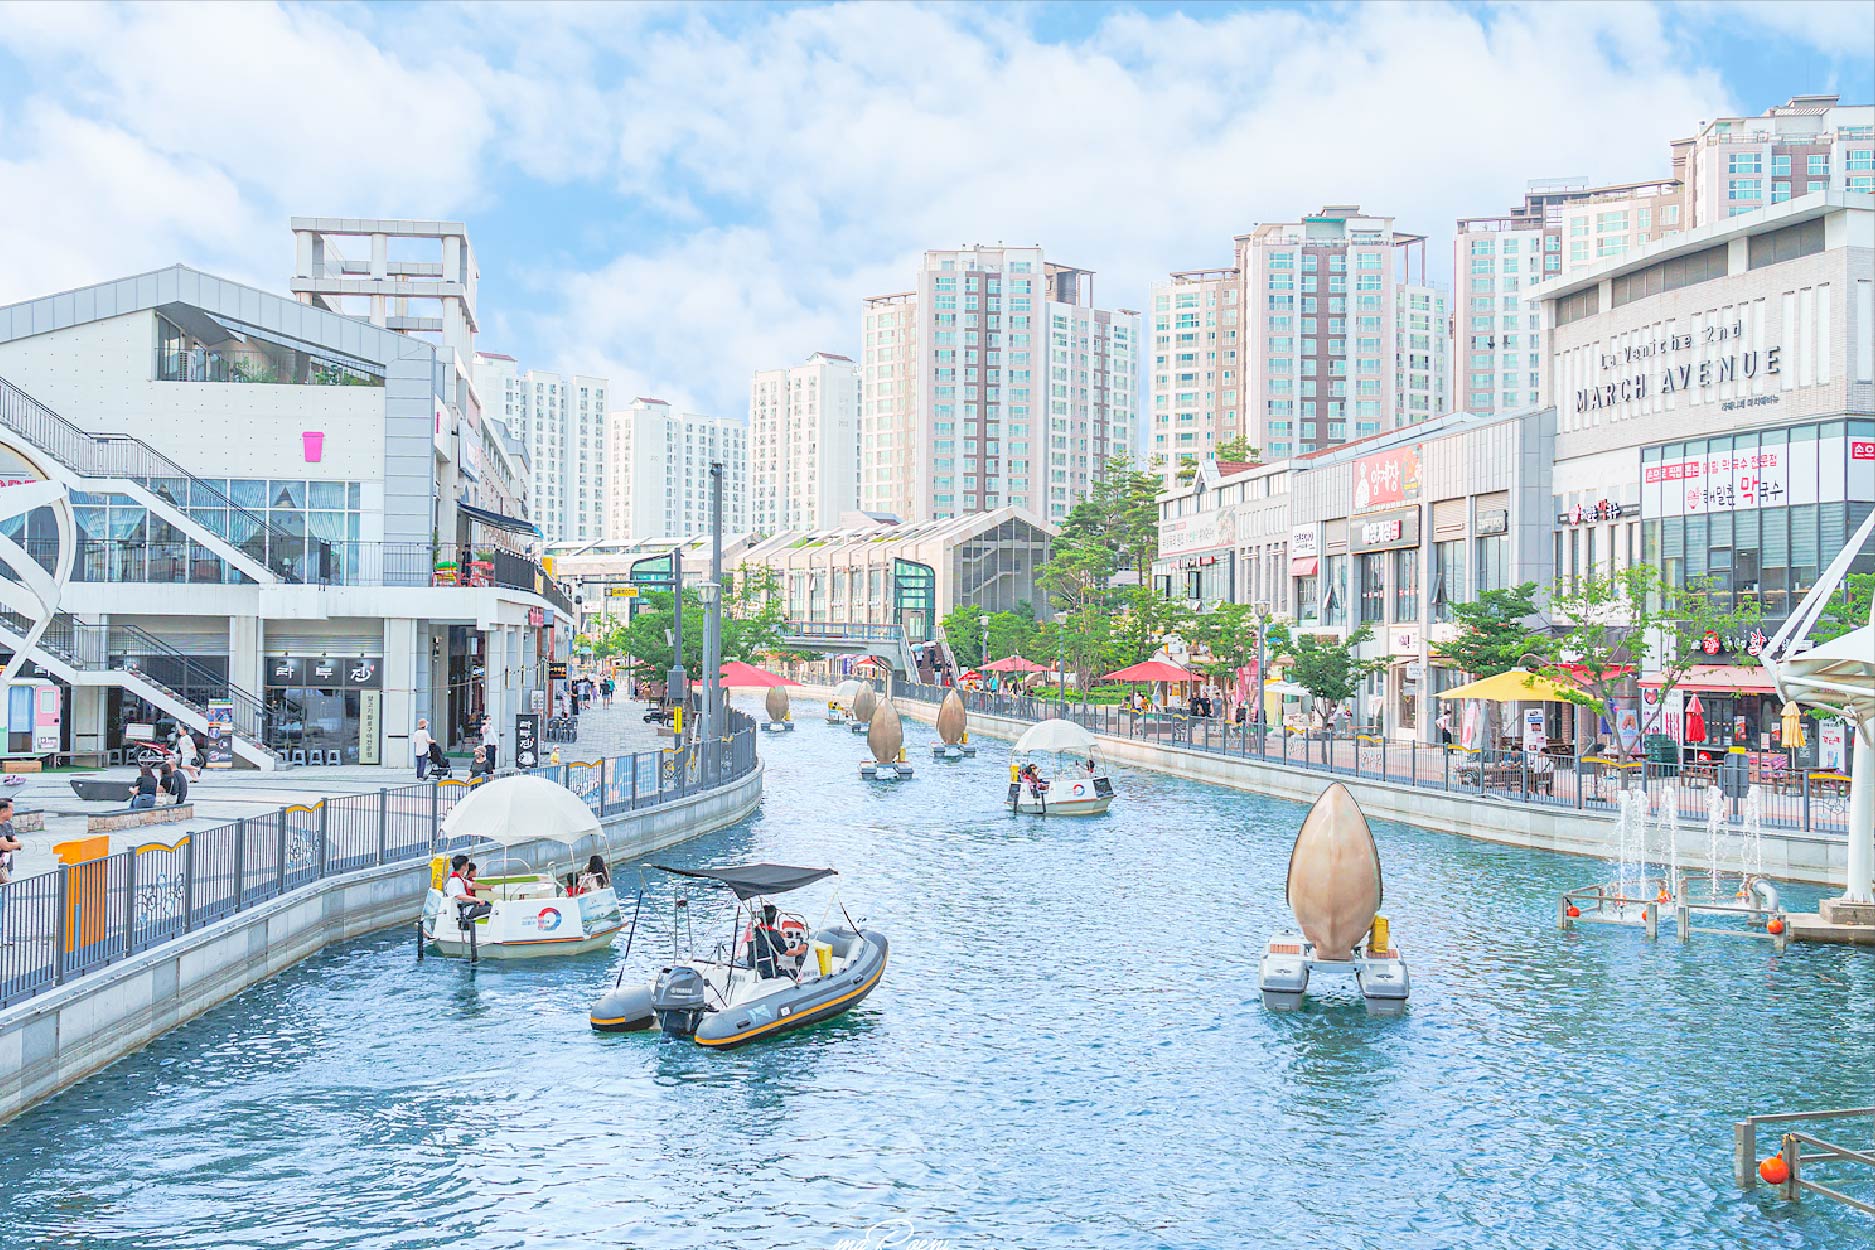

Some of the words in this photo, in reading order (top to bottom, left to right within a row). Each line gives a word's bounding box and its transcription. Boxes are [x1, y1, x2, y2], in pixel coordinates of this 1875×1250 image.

[1705, 319, 1742, 343] 2nd
[1577, 373, 1646, 412] MARCH
[1660, 345, 1782, 394] AVENUE
